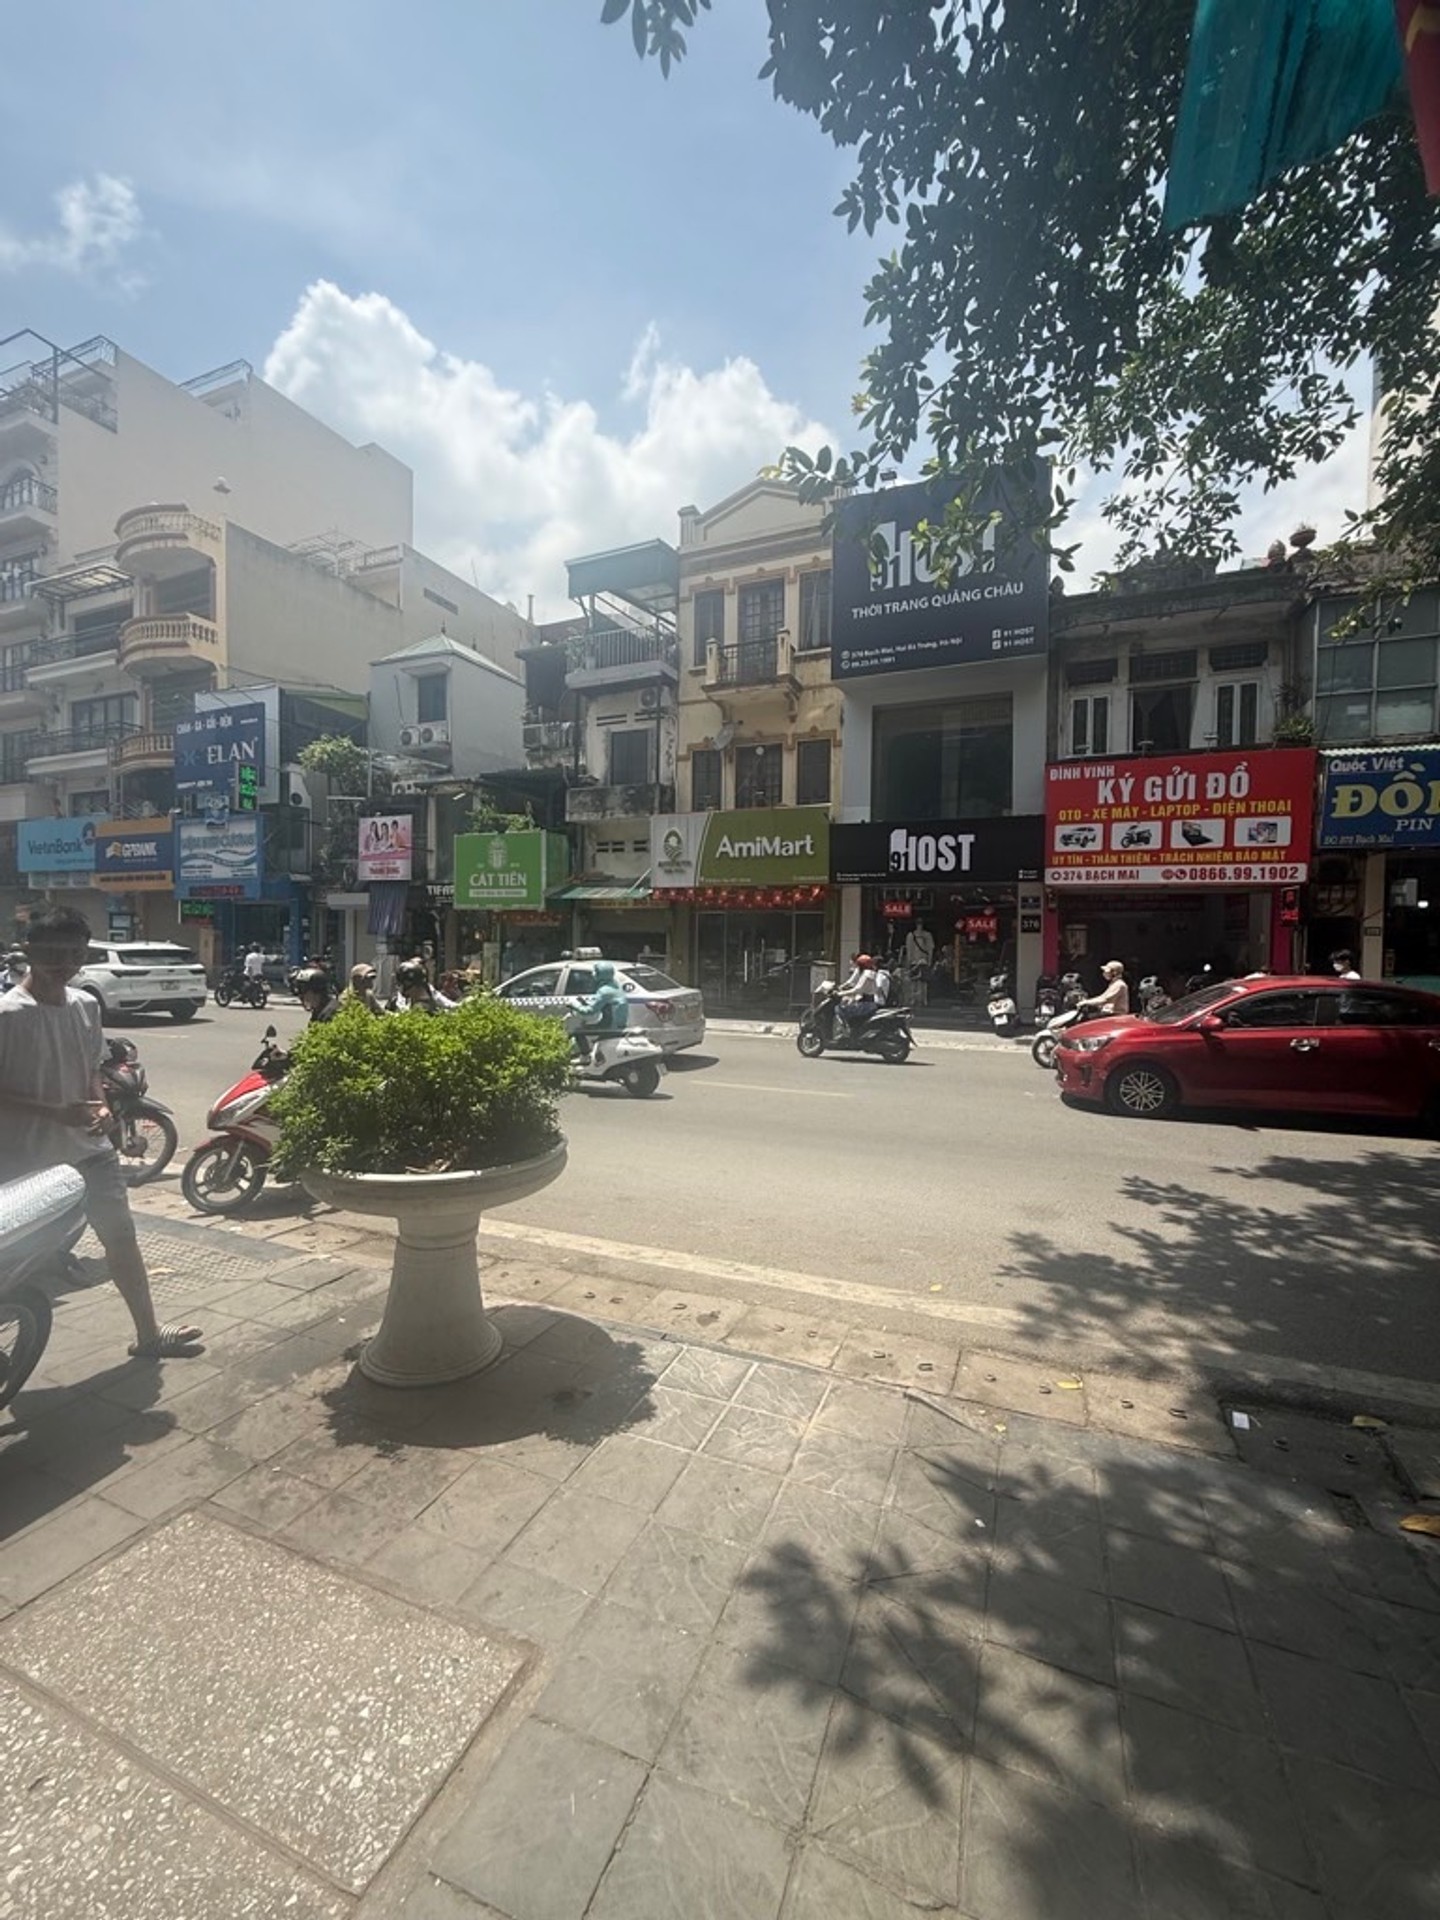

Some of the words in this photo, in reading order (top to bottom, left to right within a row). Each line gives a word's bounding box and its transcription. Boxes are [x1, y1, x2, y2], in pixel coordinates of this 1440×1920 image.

[852, 603, 882, 619] THỜI
[884, 596, 929, 614] TRANG
[931, 588, 981, 608] QUẢNG
[984, 582, 1023, 599] CHÂU
[207, 741, 255, 765] ELAN
[1330, 758, 1368, 772] Quốc
[1372, 756, 1404, 771] Việt
[1050, 766, 1081, 781] ĐÌNH
[1083, 765, 1115, 779] VINH
[1097, 772, 1135, 805] KÝ
[1144, 765, 1197, 803] GỬI
[1206, 761, 1250, 799] ĐỒ
[1059, 809, 1082, 822] OTO
[1093, 808, 1108, 820] XE
[1111, 805, 1139, 819] MÁY
[1150, 803, 1201, 817] LAPTOP
[1213, 799, 1247, 817] ĐIỆN
[1249, 799, 1292, 815] THOẠI
[1394, 818, 1435, 832] PIN
[715, 834, 815, 859] AmiMart
[470, 872, 495, 887] CÁT
[1063, 870, 1082, 881] 374
[1085, 869, 1115, 882] BẠCH
[1117, 869, 1140, 881] MAI
[1189, 866, 1299, 881] 0866.99.1902
[884, 904, 911, 914] SALE
[968, 918, 997, 929] SALE
